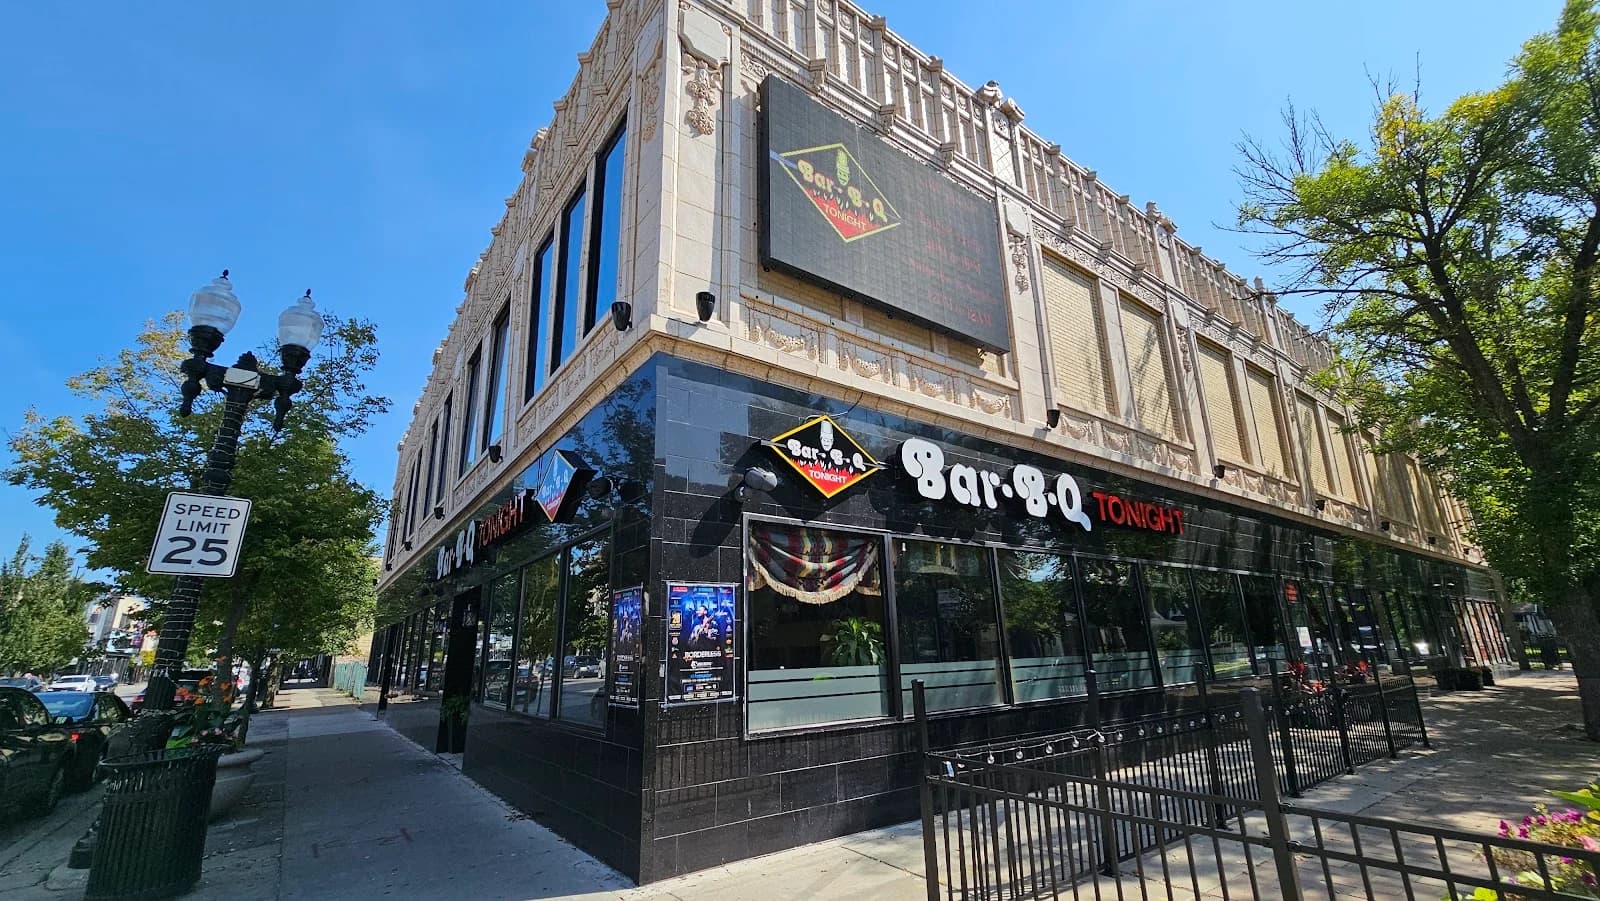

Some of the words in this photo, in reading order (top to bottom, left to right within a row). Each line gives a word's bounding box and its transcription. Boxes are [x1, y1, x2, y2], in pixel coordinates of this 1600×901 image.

[824, 203, 866, 230] TONIGHT
[809, 469, 847, 483] TONIGHT
[174, 503, 241, 519] SPEED
[478, 490, 526, 549] TONIGHT
[1092, 491, 1184, 535] TONIGHT
[176, 519, 231, 534] LIMIT
[161, 536, 229, 566] 25
